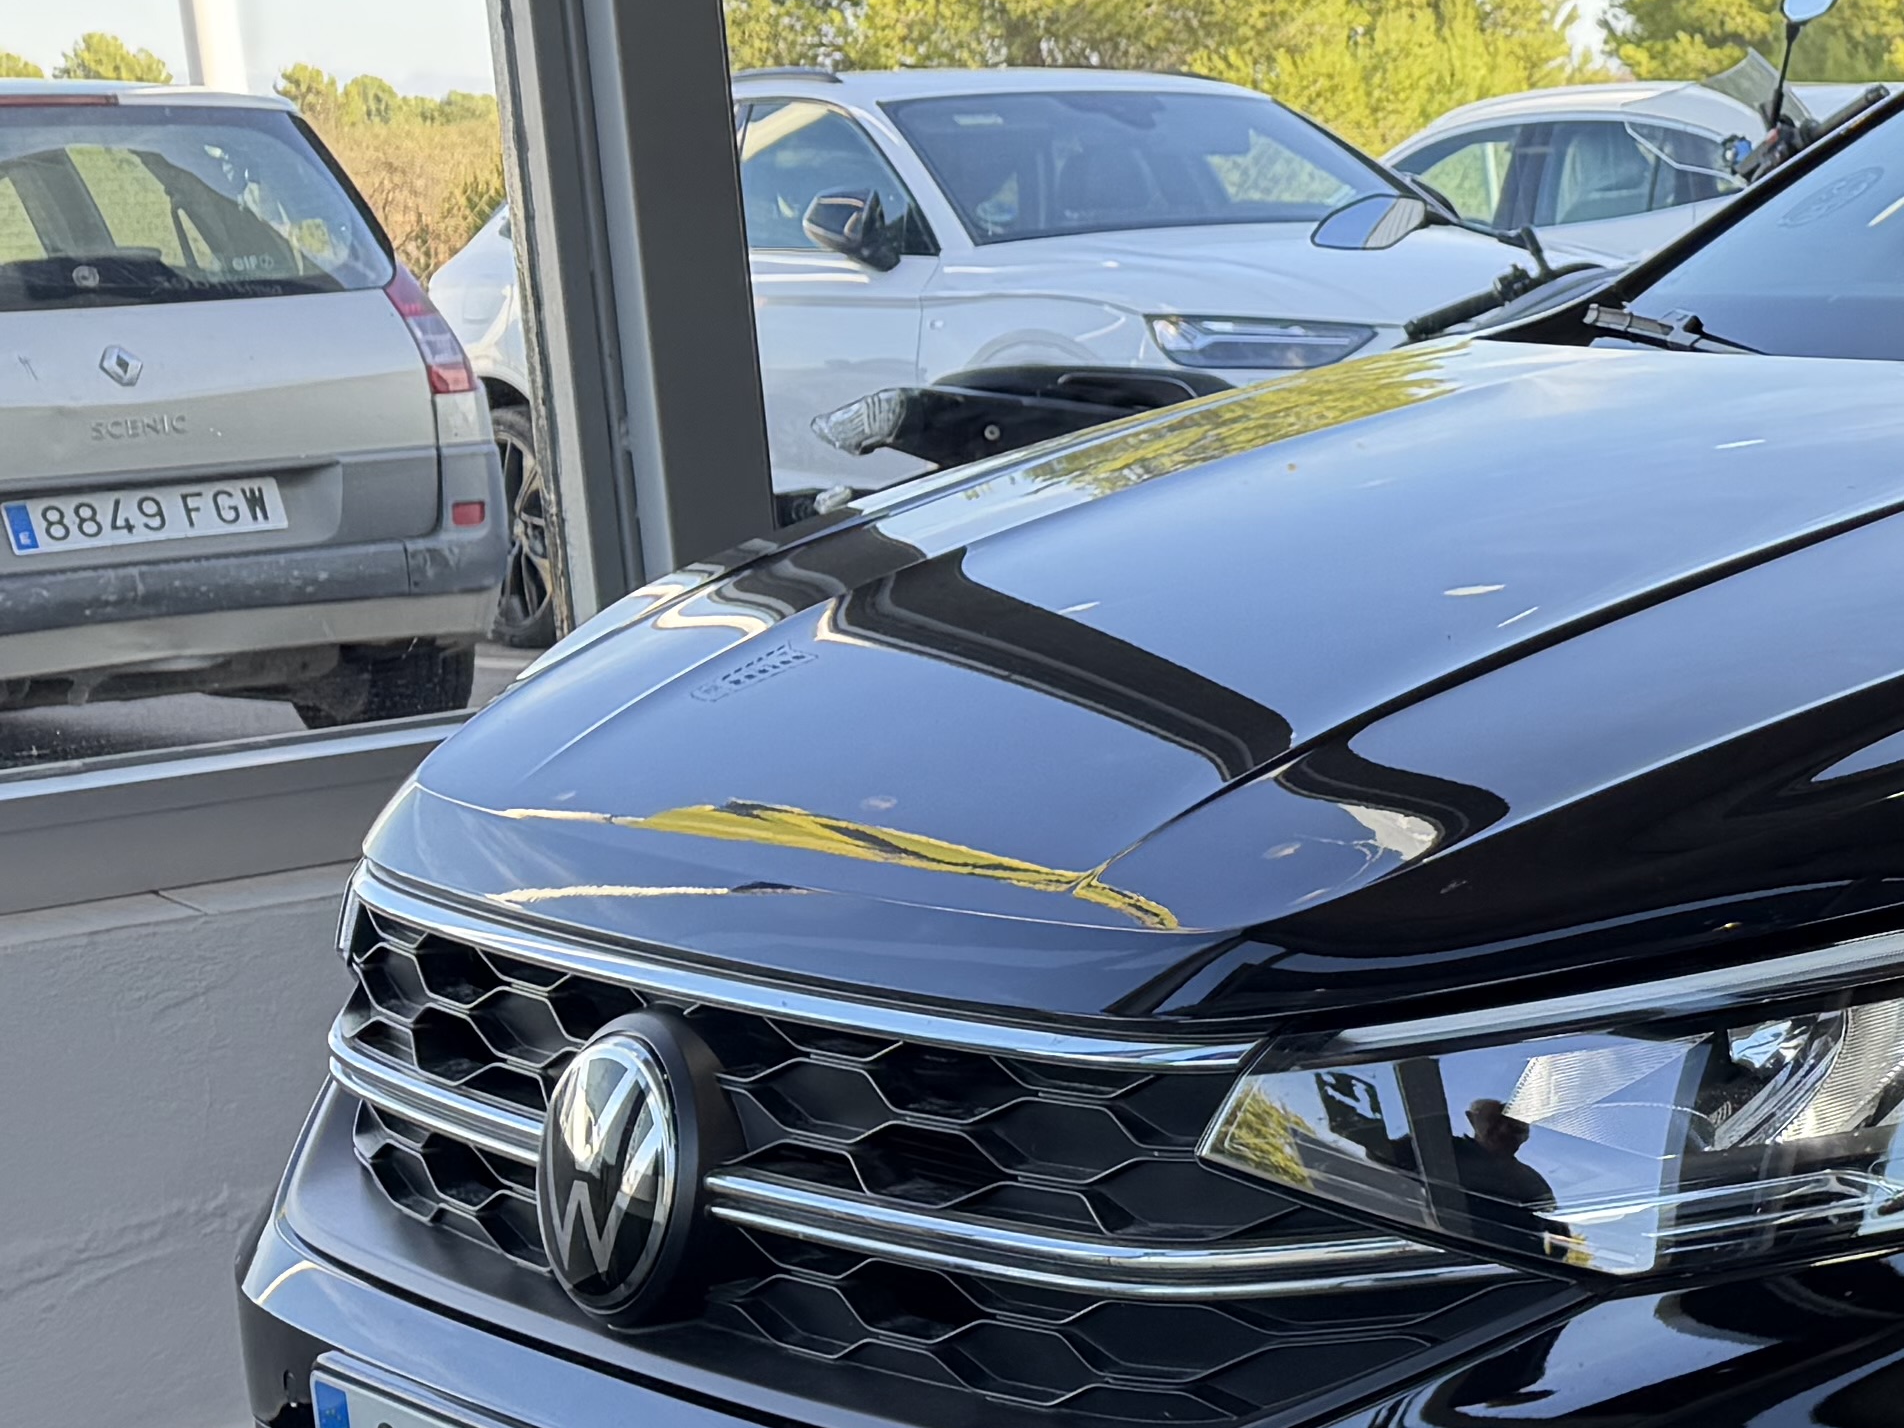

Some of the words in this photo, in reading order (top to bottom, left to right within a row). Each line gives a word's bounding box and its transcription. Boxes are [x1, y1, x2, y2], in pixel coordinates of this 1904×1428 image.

[90, 413, 188, 442] SCENIC
[41, 495, 166, 542] 8849
[180, 485, 271, 529] FGW
